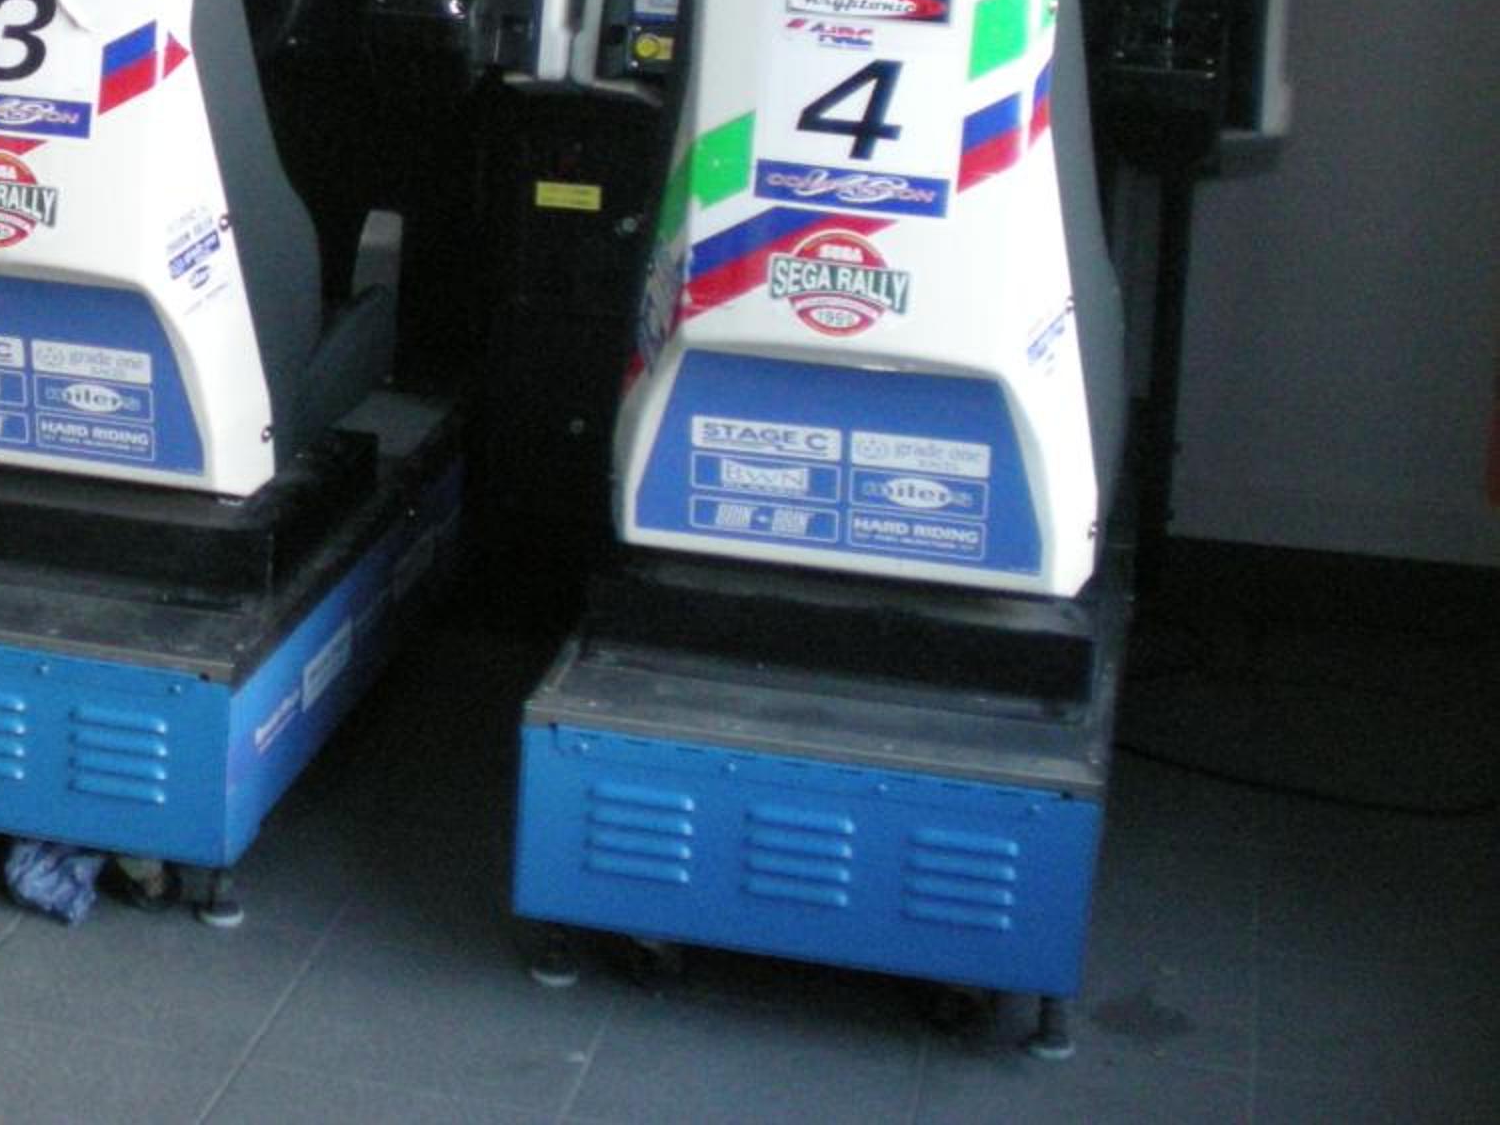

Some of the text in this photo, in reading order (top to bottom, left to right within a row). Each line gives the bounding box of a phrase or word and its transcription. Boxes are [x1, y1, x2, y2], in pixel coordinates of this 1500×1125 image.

[795, 58, 904, 161] 4
[770, 258, 909, 314] SEGA RALLY
[41, 422, 150, 448] HARD RIDING
[702, 421, 830, 451] STAGE C
[853, 517, 980, 546] HARD RIDING
